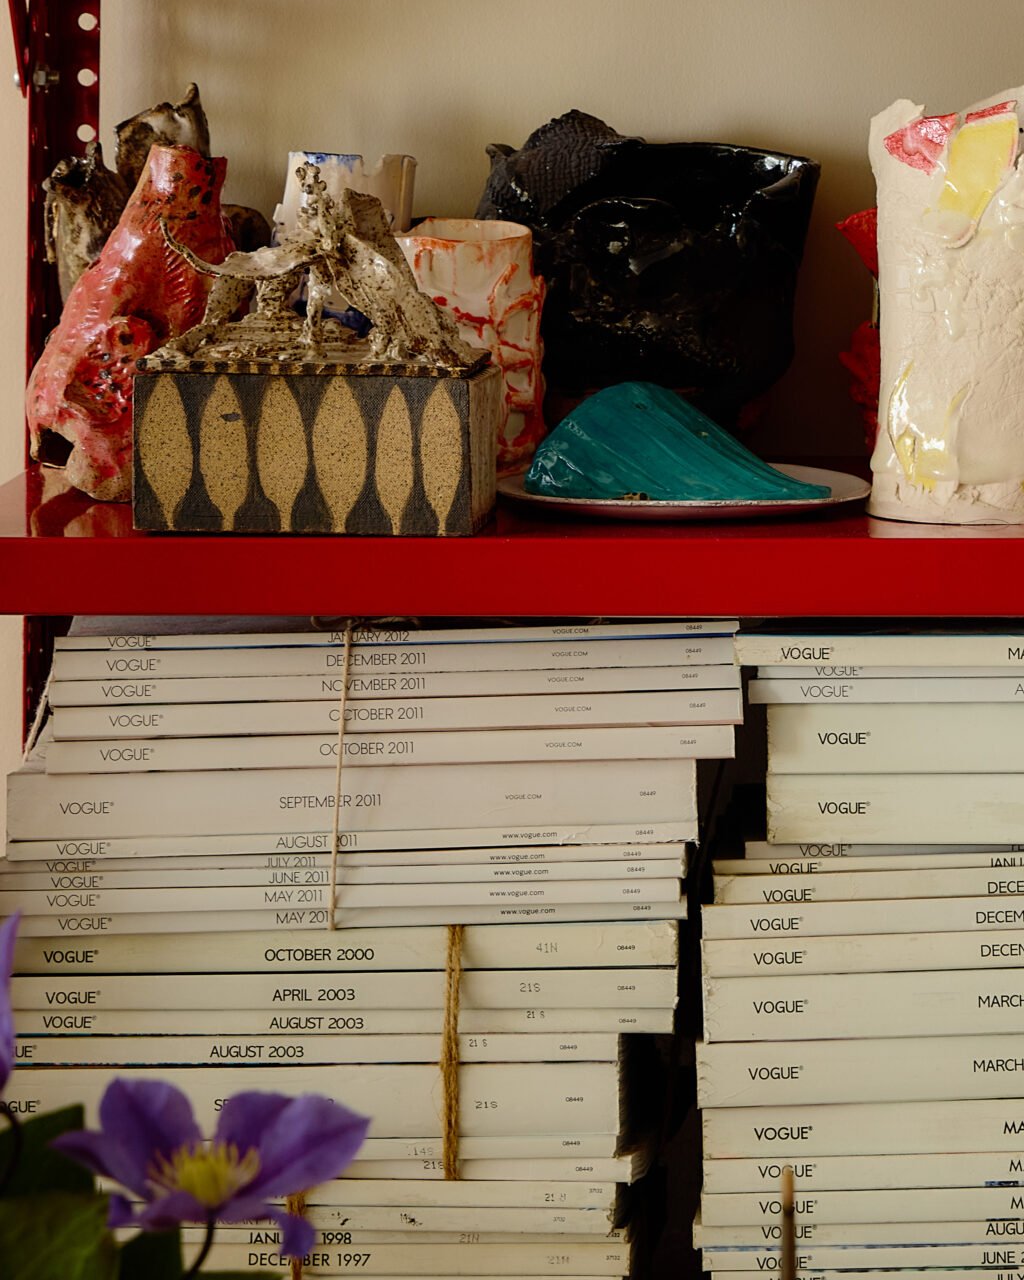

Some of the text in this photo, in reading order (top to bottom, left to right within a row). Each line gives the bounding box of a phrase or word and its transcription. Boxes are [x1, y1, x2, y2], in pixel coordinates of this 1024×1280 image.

[264, 890, 294, 903] MAY
[297, 889, 323, 903] 2011
[489, 890, 545, 898] www.vogue.com
[264, 948, 332, 962] OCTOBER
[336, 948, 375, 961] 2000
[271, 988, 313, 1002] APRIL
[317, 988, 356, 1002] 2003
[209, 1045, 265, 1058] AUGUST
[268, 1045, 305, 1058] 2003
